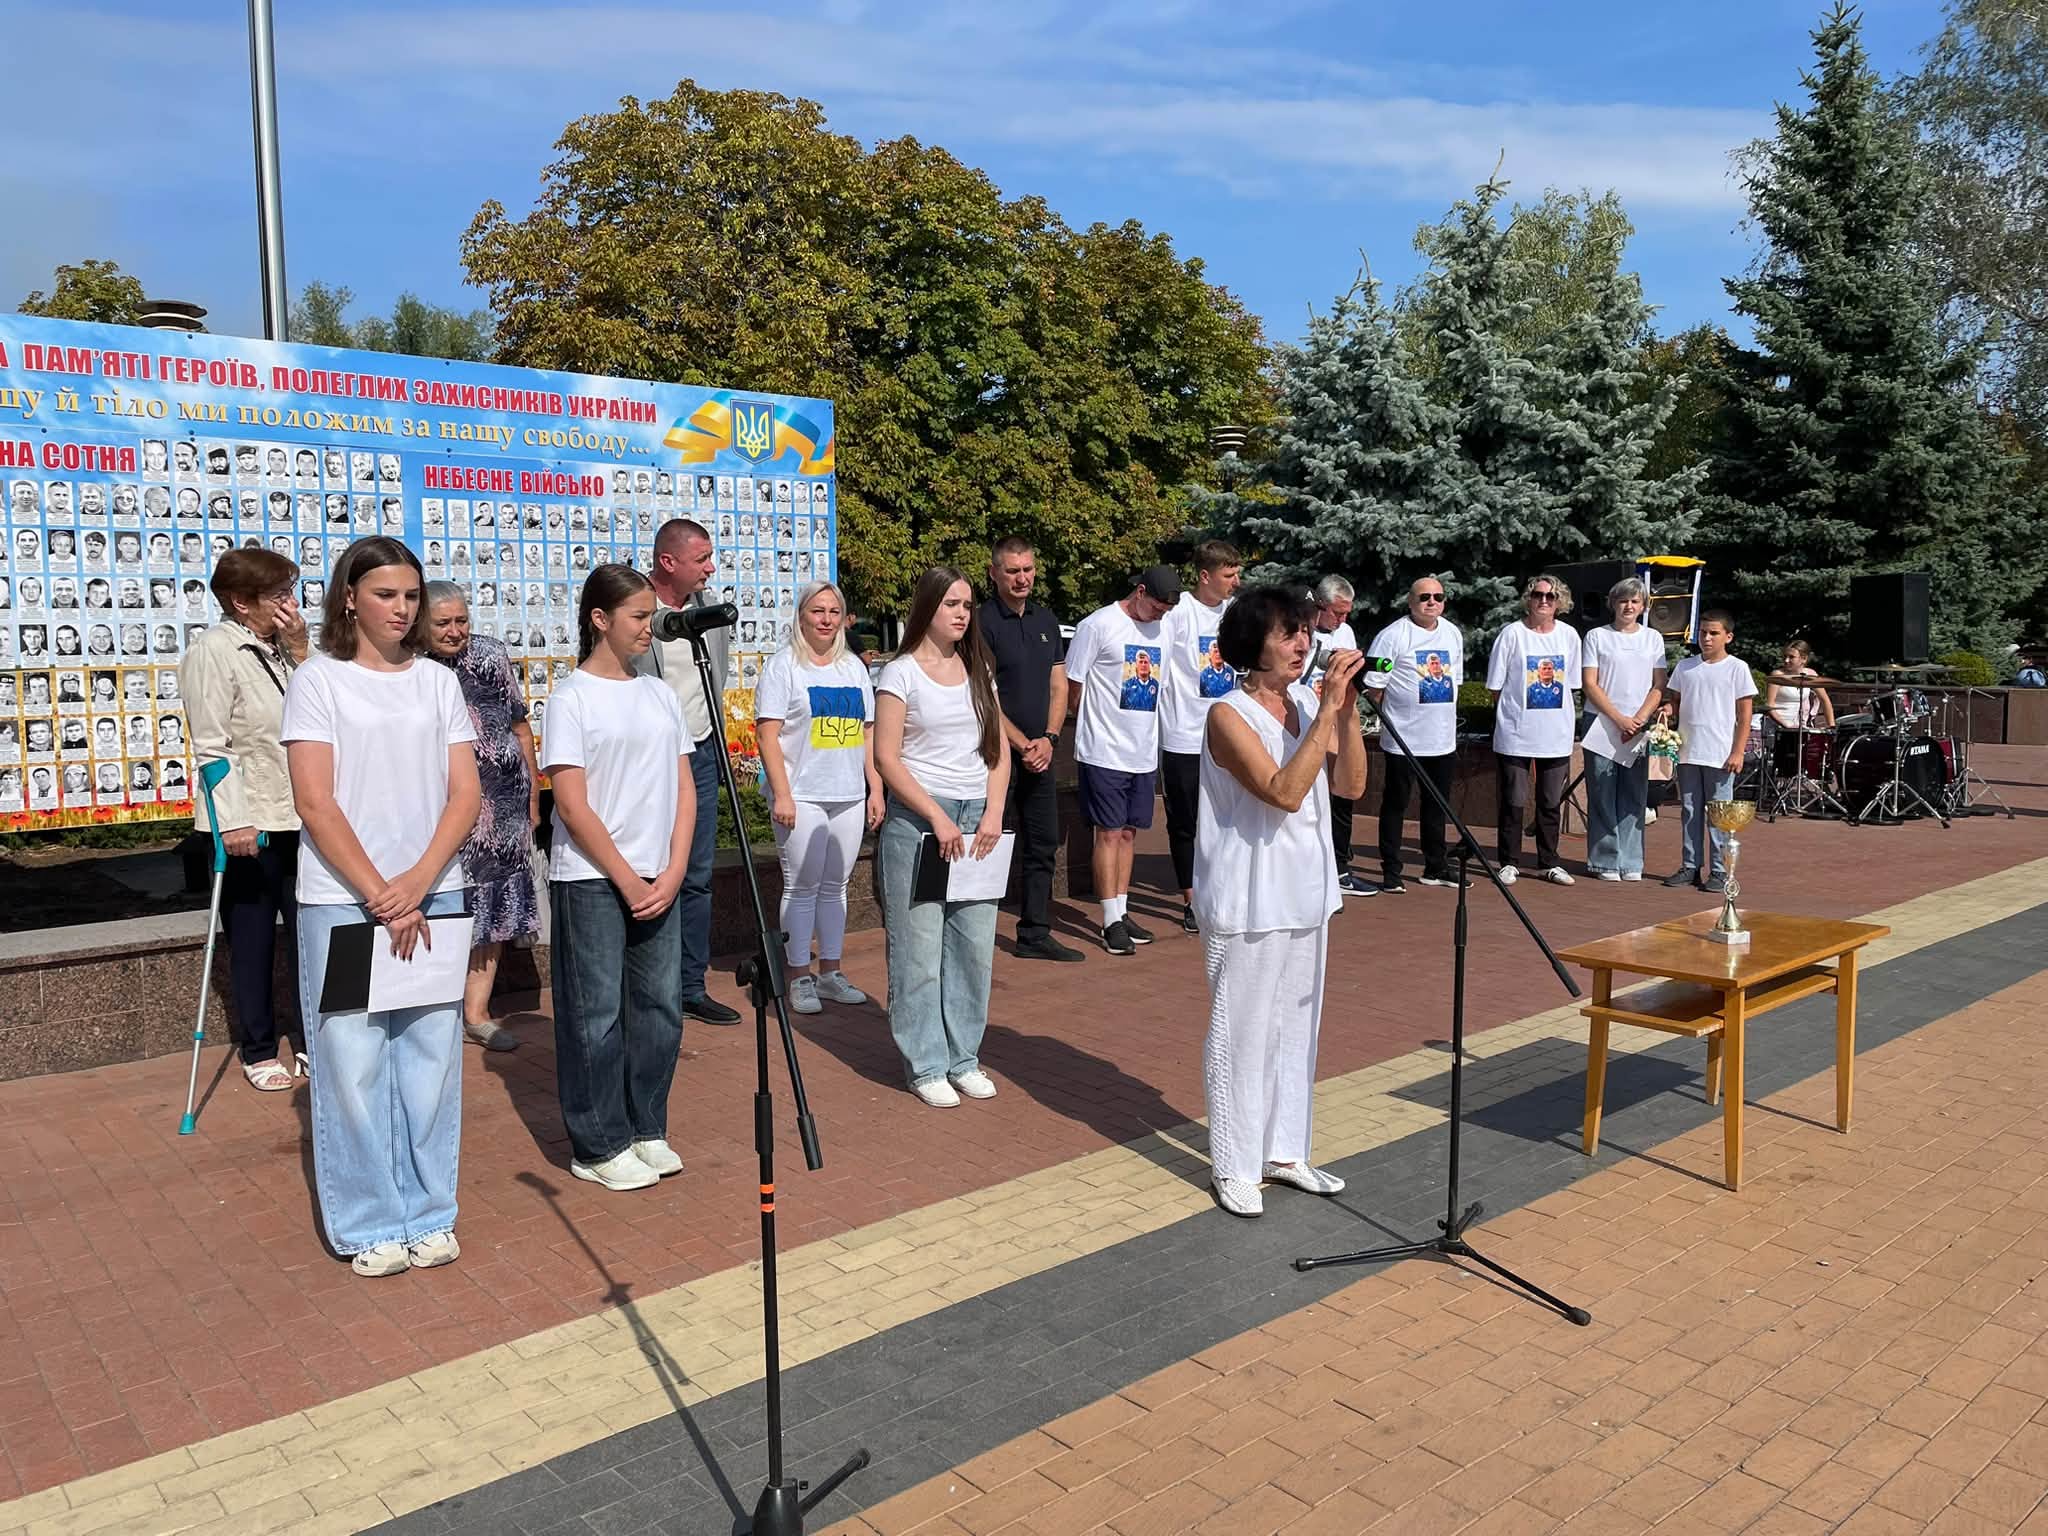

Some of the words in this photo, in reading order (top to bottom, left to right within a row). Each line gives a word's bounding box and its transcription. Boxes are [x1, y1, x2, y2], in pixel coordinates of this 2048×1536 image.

[158, 355, 266, 392] ГЕРОЇВ,
[272, 366, 408, 402] ПОЛЕГЛИХ
[414, 380, 564, 415] ЗАХИСНИКІВ
[568, 395, 658, 422] УКРАЇНИ
[55, 386, 80, 413] й
[90, 387, 169, 418] тіло
[178, 402, 228, 423] ми
[238, 406, 393, 434] положим
[401, 417, 431, 436] за
[439, 421, 517, 450] нашу
[524, 427, 651, 459] свободу...
[42, 442, 136, 473] СОТНЯ
[424, 465, 514, 493] НЕБЕСНЕ
[520, 468, 605, 498] ВІЙСЬКО
[1910, 744, 1930, 755] TAMA
